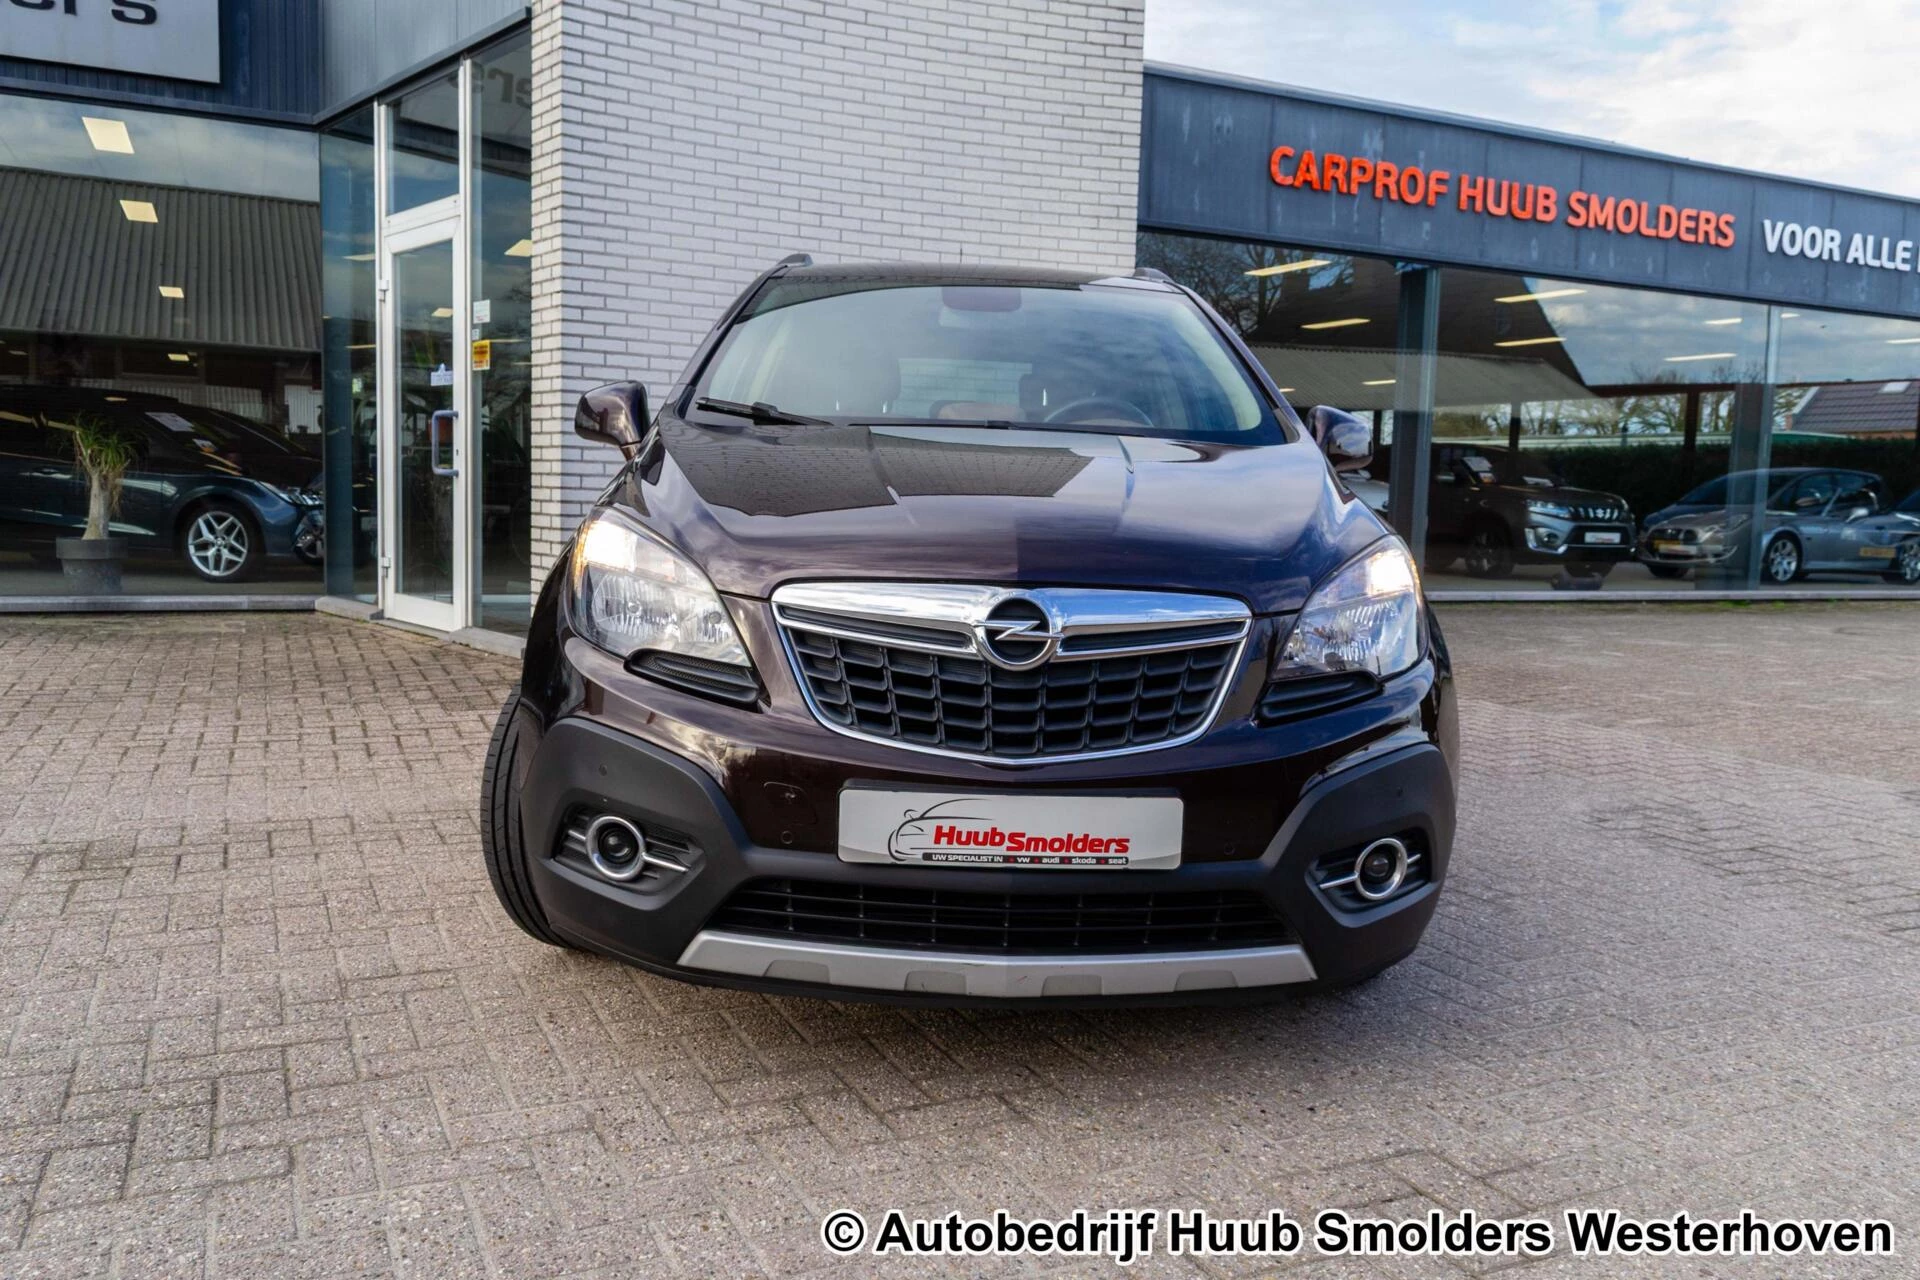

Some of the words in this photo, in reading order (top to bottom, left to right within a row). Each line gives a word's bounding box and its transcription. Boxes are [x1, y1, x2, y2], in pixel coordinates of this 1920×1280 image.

[1270, 145, 1449, 207] CARPROF
[1459, 174, 1558, 222] HUUB
[1566, 191, 1736, 248] SMOLDERS
[1763, 219, 1841, 262] VOOR
[1846, 233, 1913, 272] ALLE
[947, 854, 993, 863] SPECIALIST
[994, 855, 1003, 863] IN
[1042, 856, 1060, 864] audi
[1071, 857, 1097, 865] skoda
[1108, 857, 1126, 865] seat
